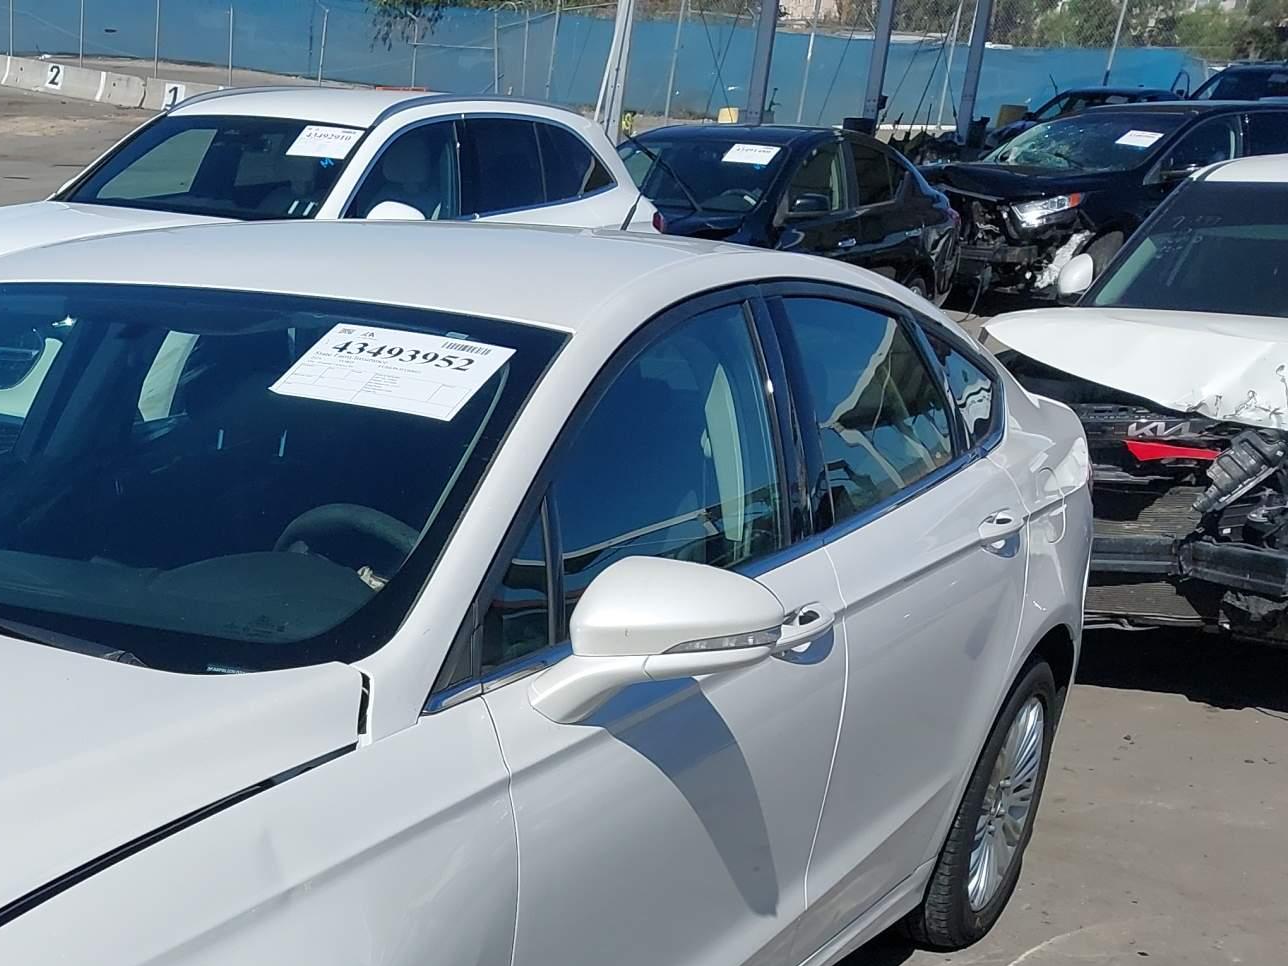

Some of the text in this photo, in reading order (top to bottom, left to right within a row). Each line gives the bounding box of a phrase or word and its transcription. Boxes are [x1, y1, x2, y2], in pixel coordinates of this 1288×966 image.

[48, 65, 61, 86] 2
[165, 86, 179, 107] 1
[332, 340, 475, 372] 43493952
[1127, 421, 1191, 437] KIA
